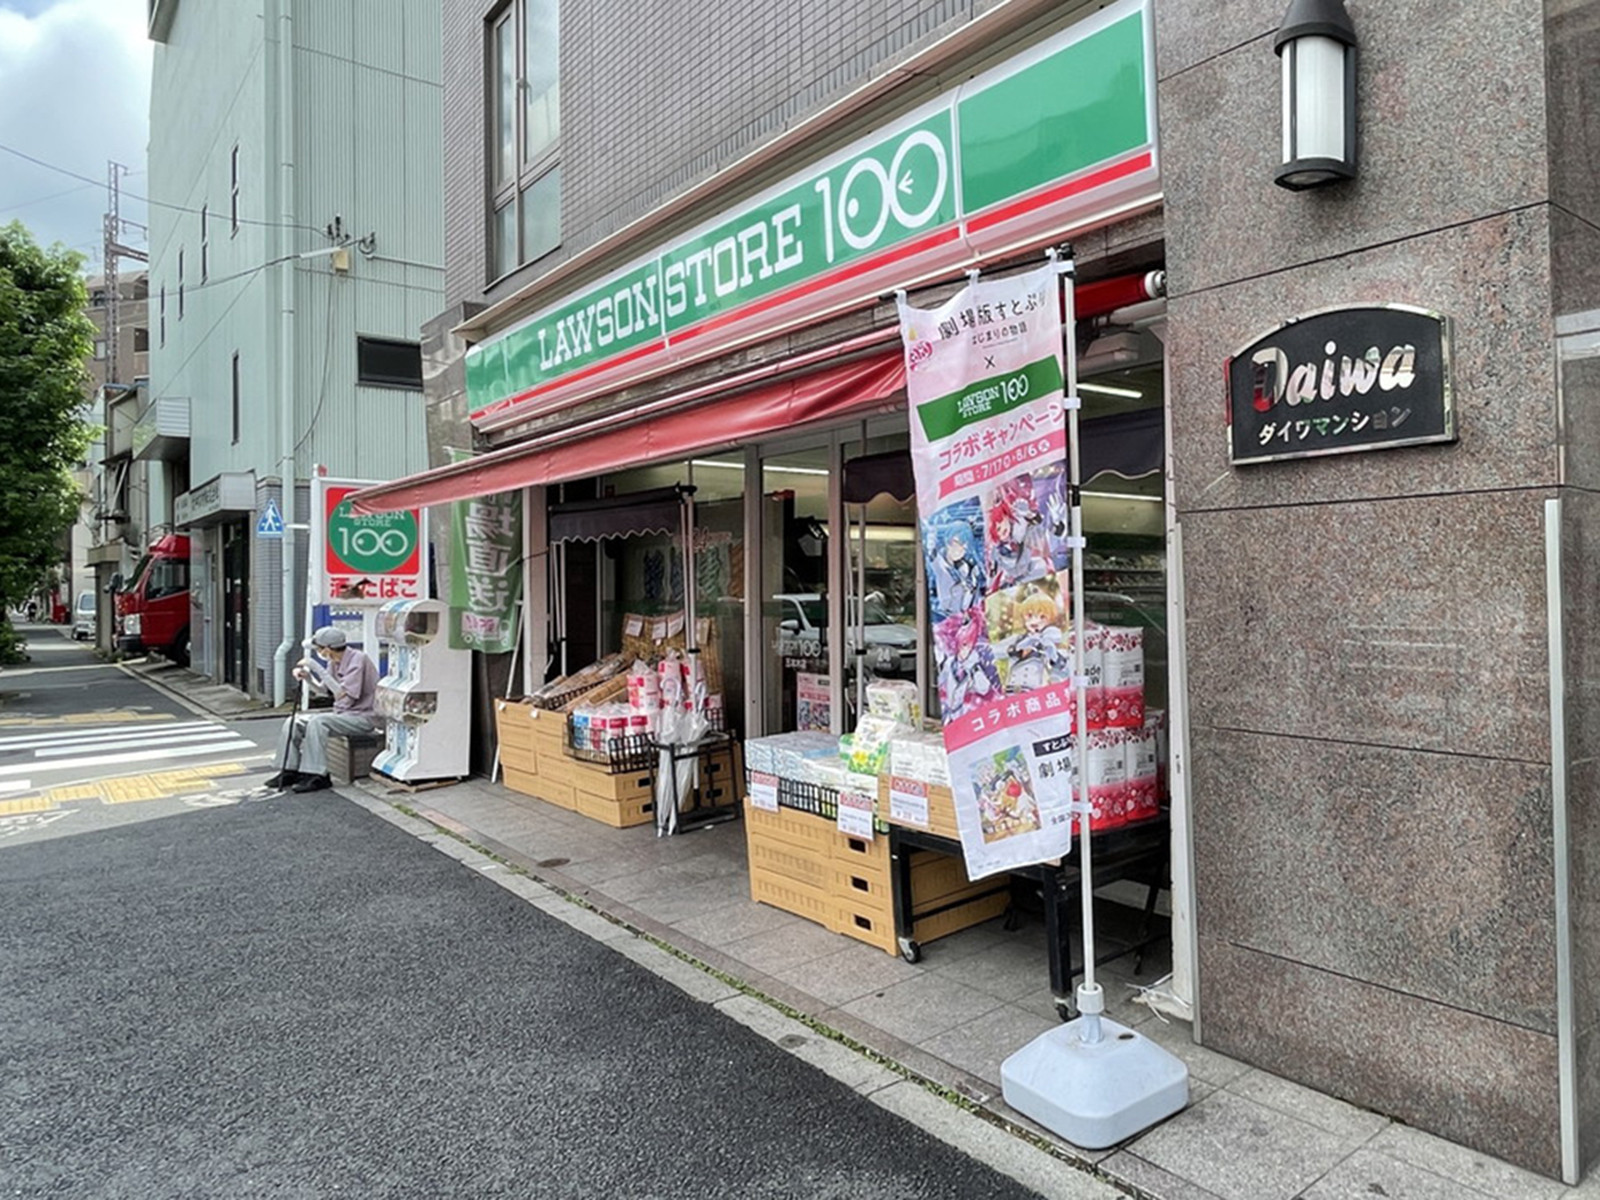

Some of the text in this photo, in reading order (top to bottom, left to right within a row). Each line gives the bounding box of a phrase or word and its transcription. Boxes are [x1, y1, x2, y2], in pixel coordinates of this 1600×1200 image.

[538, 130, 948, 371] LAWSON STORE 100
[1000, 374, 1029, 404] 100
[1252, 344, 1416, 412] Daiwa
[939, 404, 1064, 471] コラボキャンペーン
[1259, 406, 1412, 446] ダイワマンション
[338, 527, 408, 557] 100
